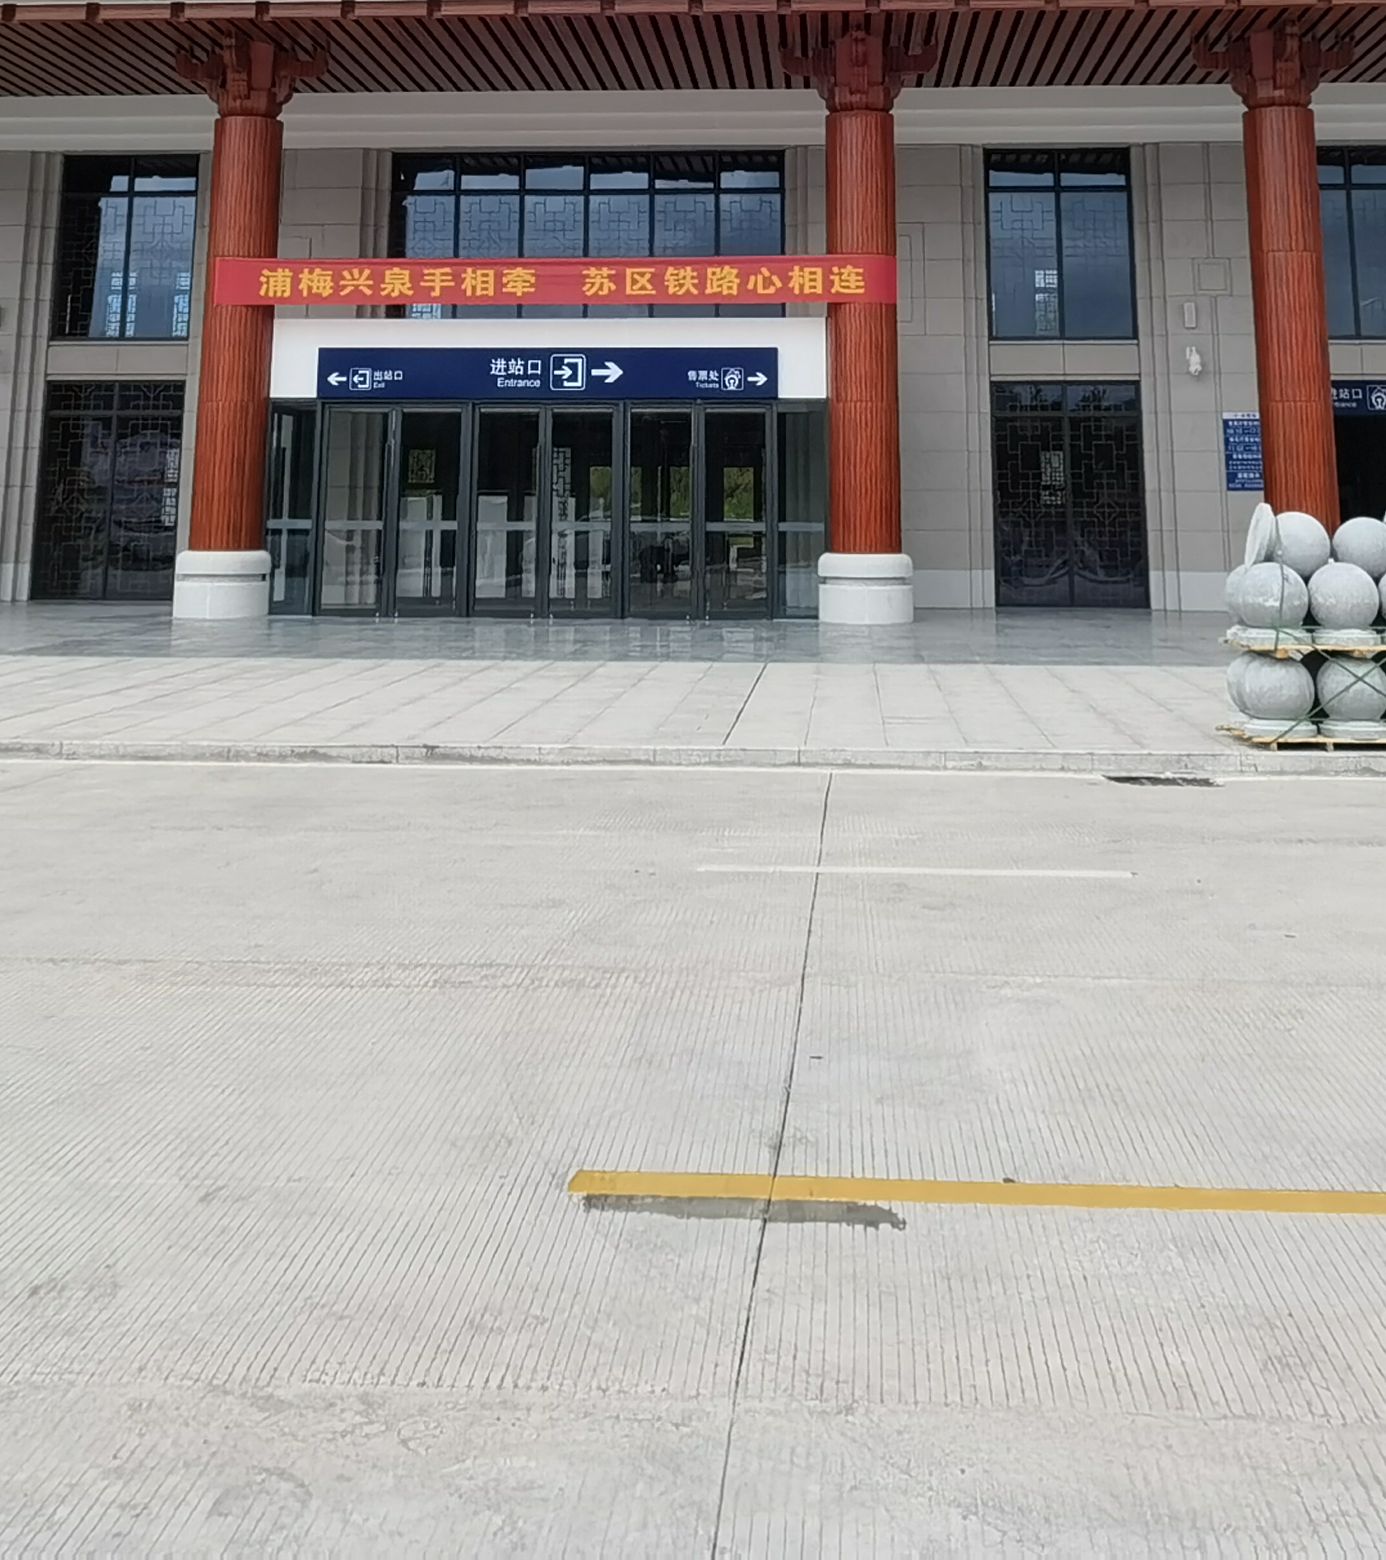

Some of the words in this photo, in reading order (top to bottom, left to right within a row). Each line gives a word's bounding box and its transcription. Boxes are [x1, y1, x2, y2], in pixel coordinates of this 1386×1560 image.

[258, 266, 537, 298] 浦梅兴泉手相牵
[581, 265, 866, 297] 苏区铁路心相连
[490, 357, 541, 375] 进站口
[373, 369, 403, 381] 出站口
[497, 377, 541, 388] Entrance
